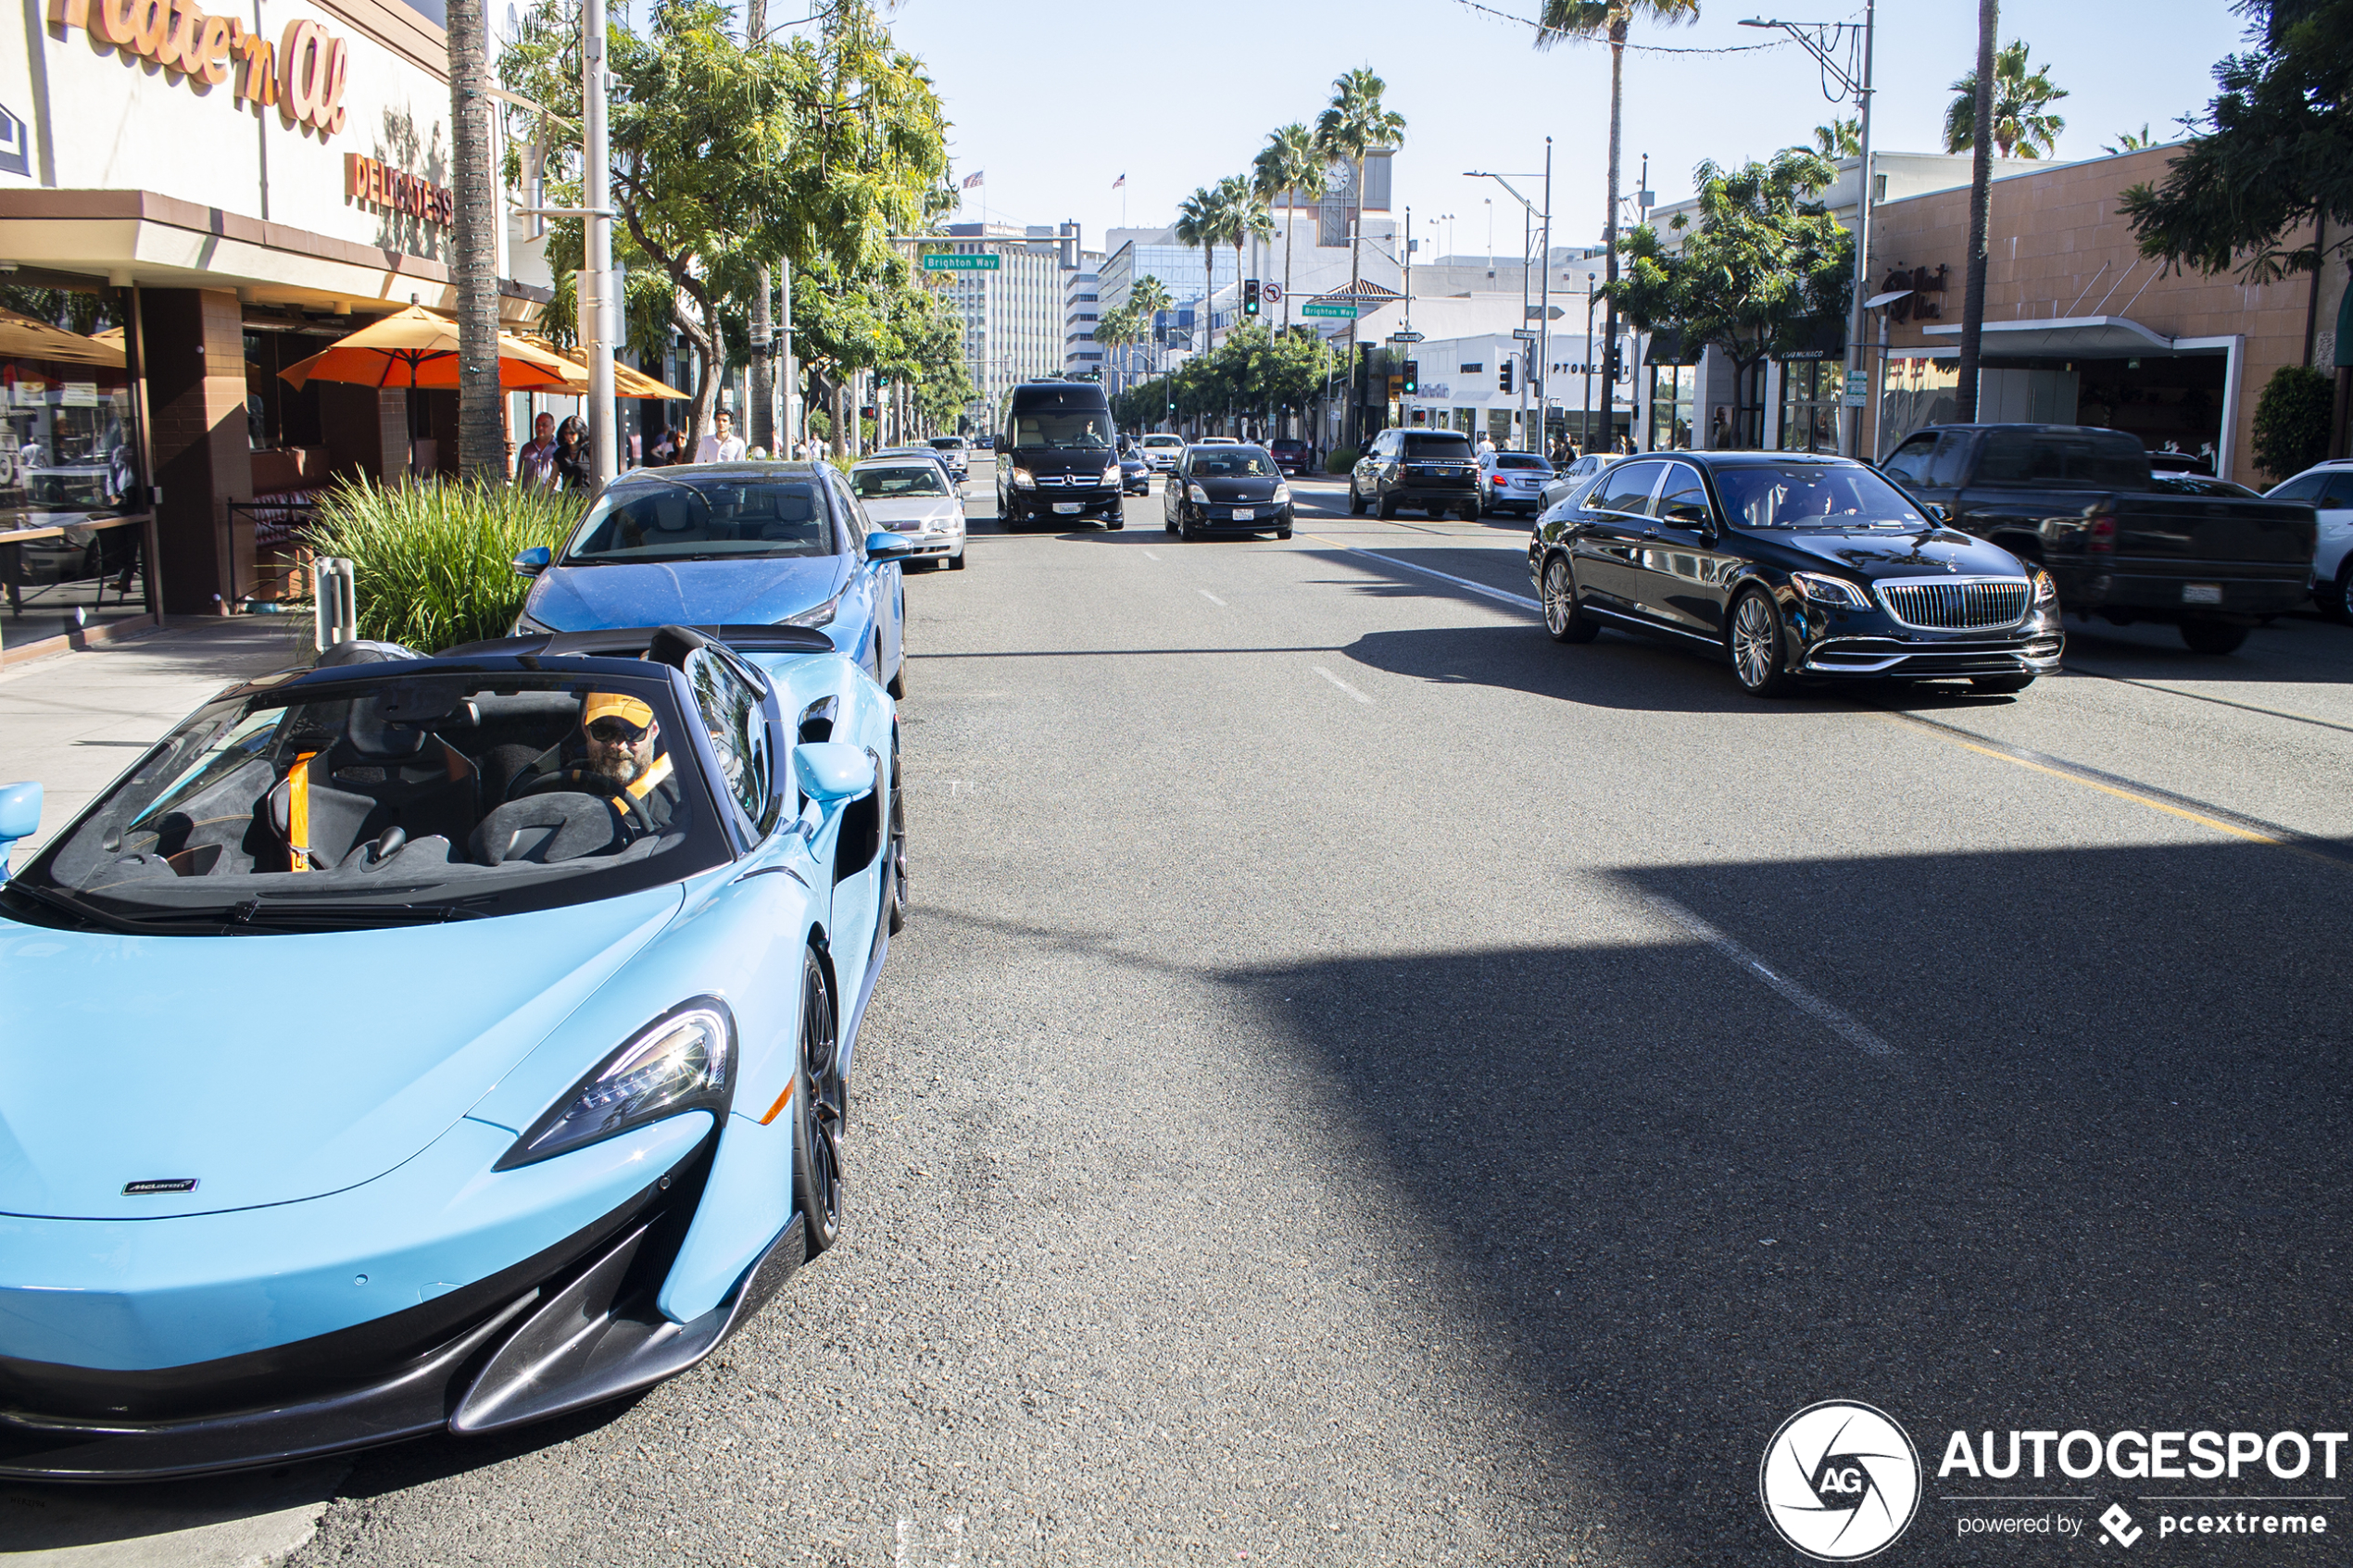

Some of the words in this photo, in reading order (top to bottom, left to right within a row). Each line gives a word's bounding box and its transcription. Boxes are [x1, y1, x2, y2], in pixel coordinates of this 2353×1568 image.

[46, 0, 282, 107] ate'n
[344, 152, 454, 228] DELICATESS
[927, 257, 972, 270] Brighton
[975, 258, 996, 270] Way
[1304, 307, 1337, 317] Brighton
[1340, 308, 1354, 318] Way
[129, 1182, 188, 1191] McLaren
